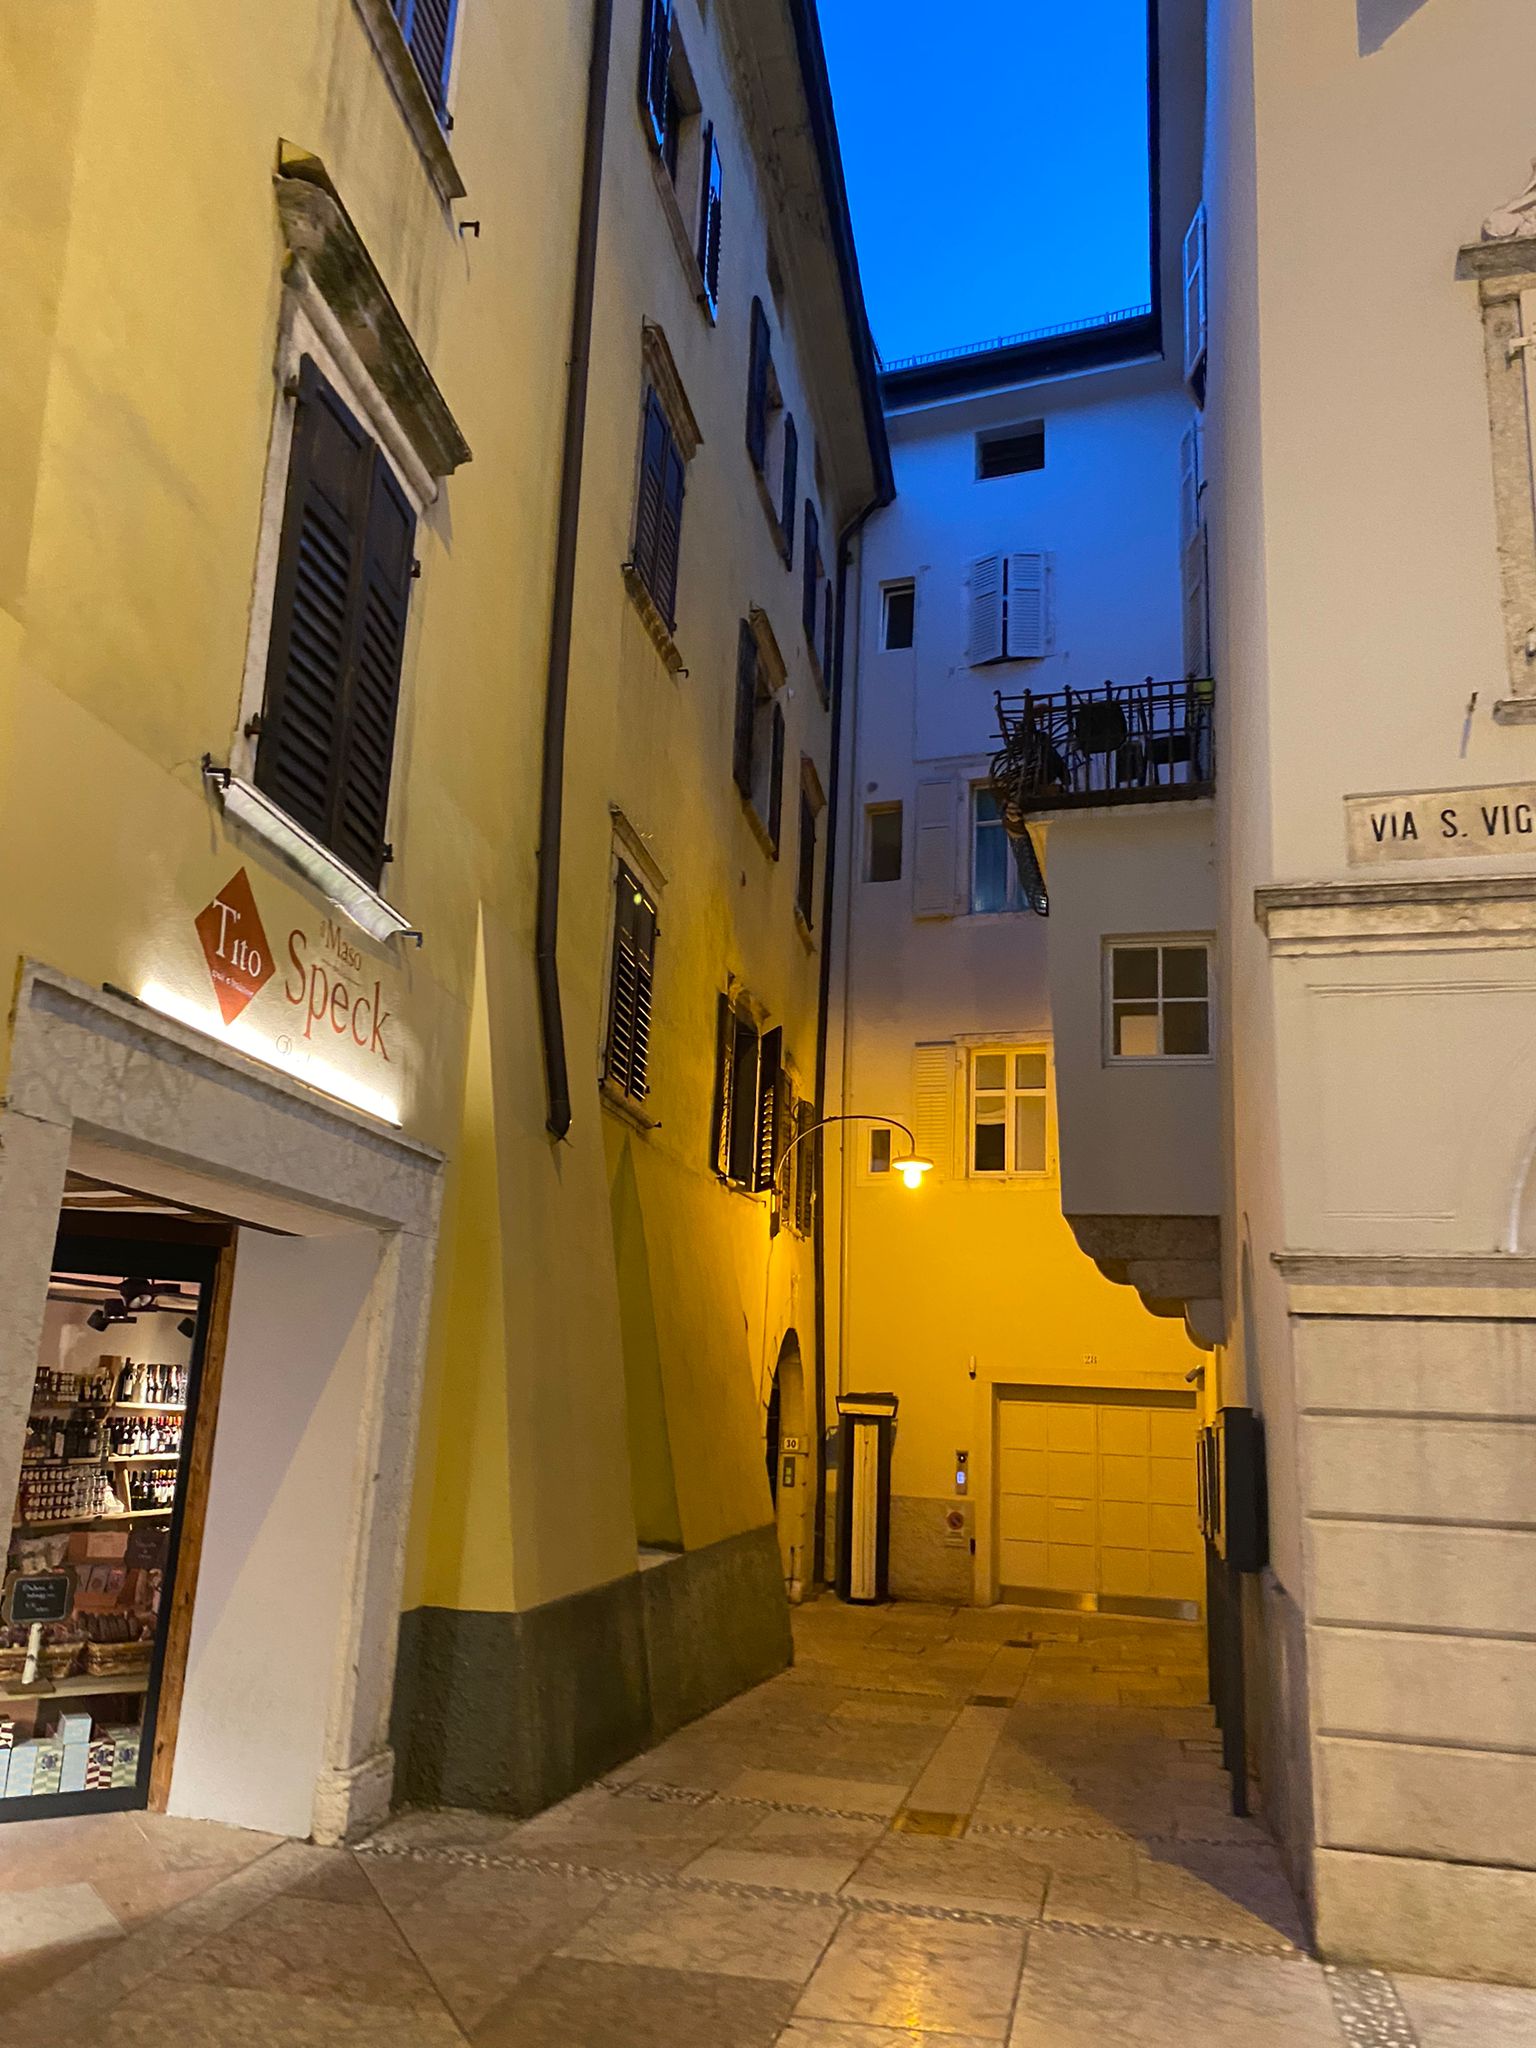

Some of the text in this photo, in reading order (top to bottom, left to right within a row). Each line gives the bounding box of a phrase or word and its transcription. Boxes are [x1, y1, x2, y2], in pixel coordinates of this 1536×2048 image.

[1370, 804, 1533, 842] VIA S. VIG
[212, 899, 262, 978] Tito
[325, 918, 362, 971] Maso
[285, 929, 391, 1062] Speck
